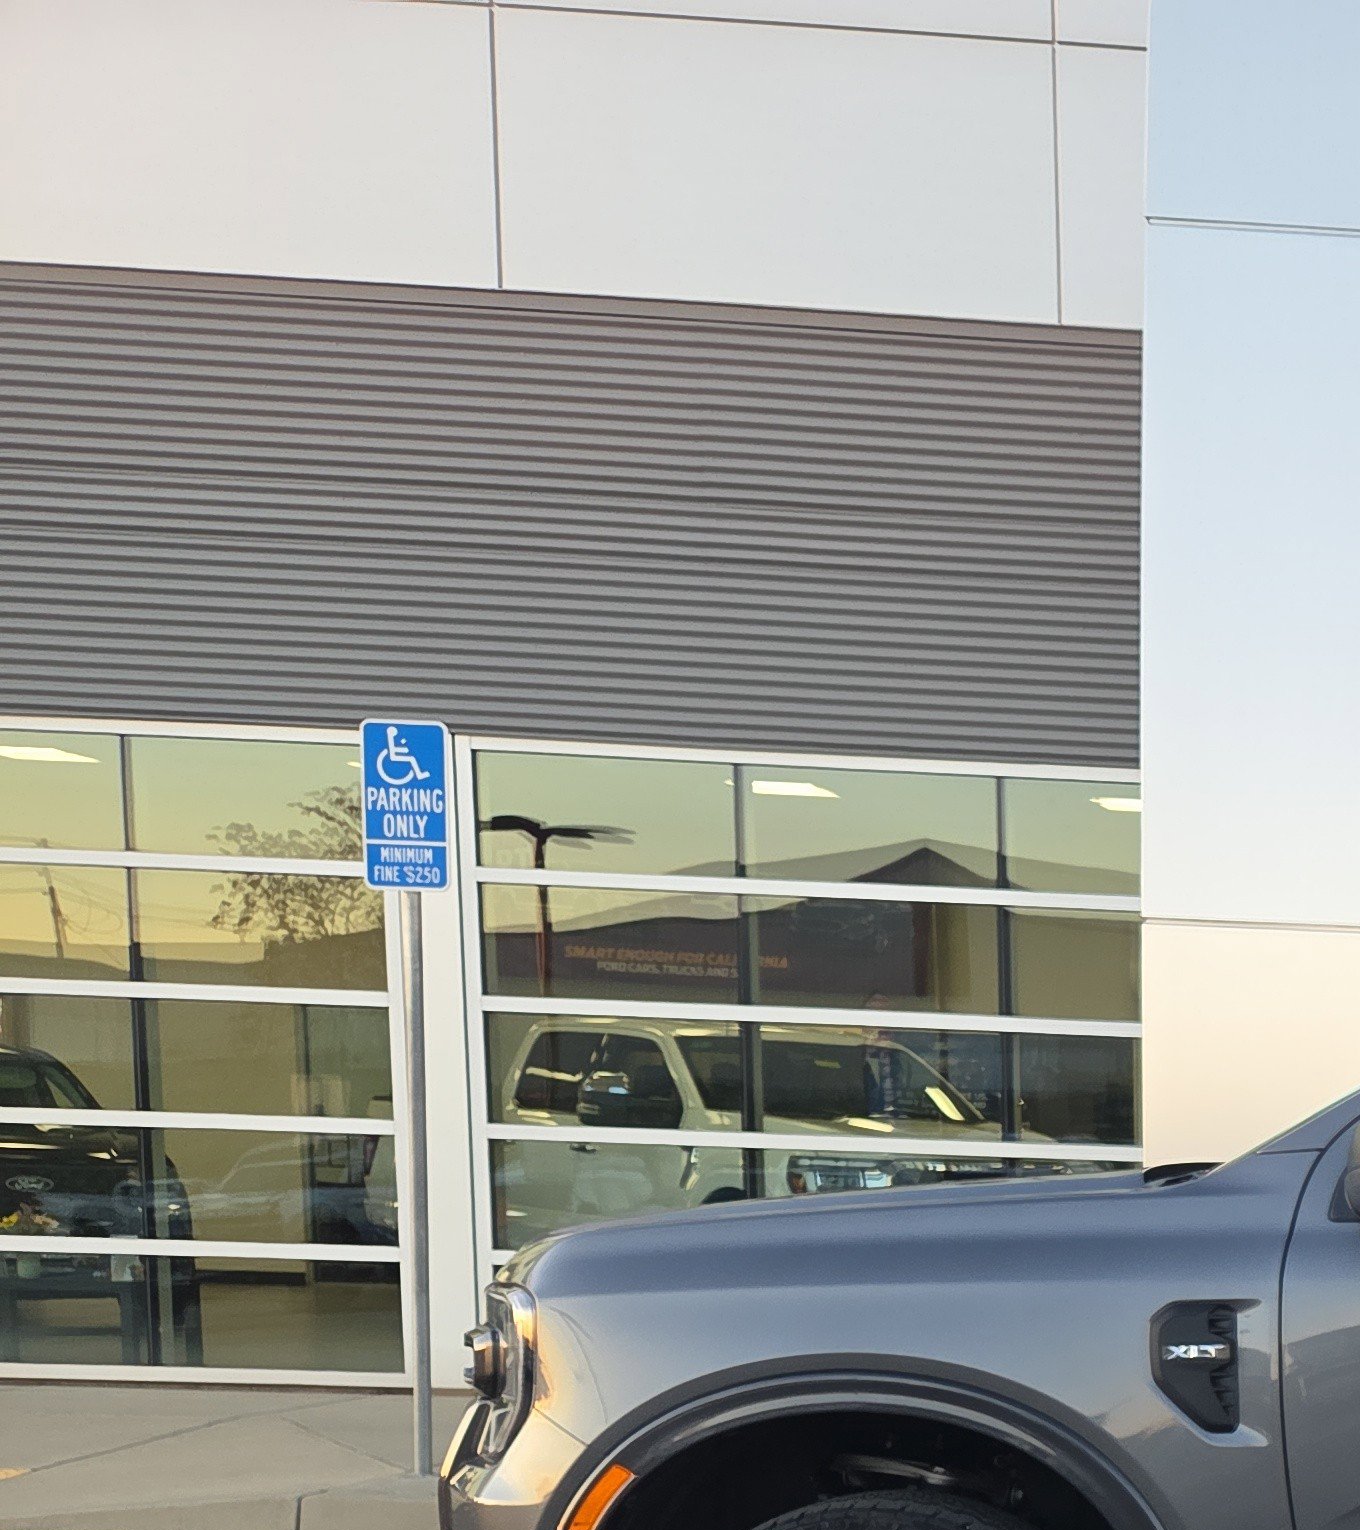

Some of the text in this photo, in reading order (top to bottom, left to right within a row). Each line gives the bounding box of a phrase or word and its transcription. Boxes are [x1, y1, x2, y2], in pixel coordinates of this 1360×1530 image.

[367, 786, 443, 814] PARKING
[383, 813, 428, 838] ONLY
[380, 846, 433, 864] MINIMUM
[373, 864, 441, 884] FINE $250
[1164, 1344, 1226, 1360] XLT
